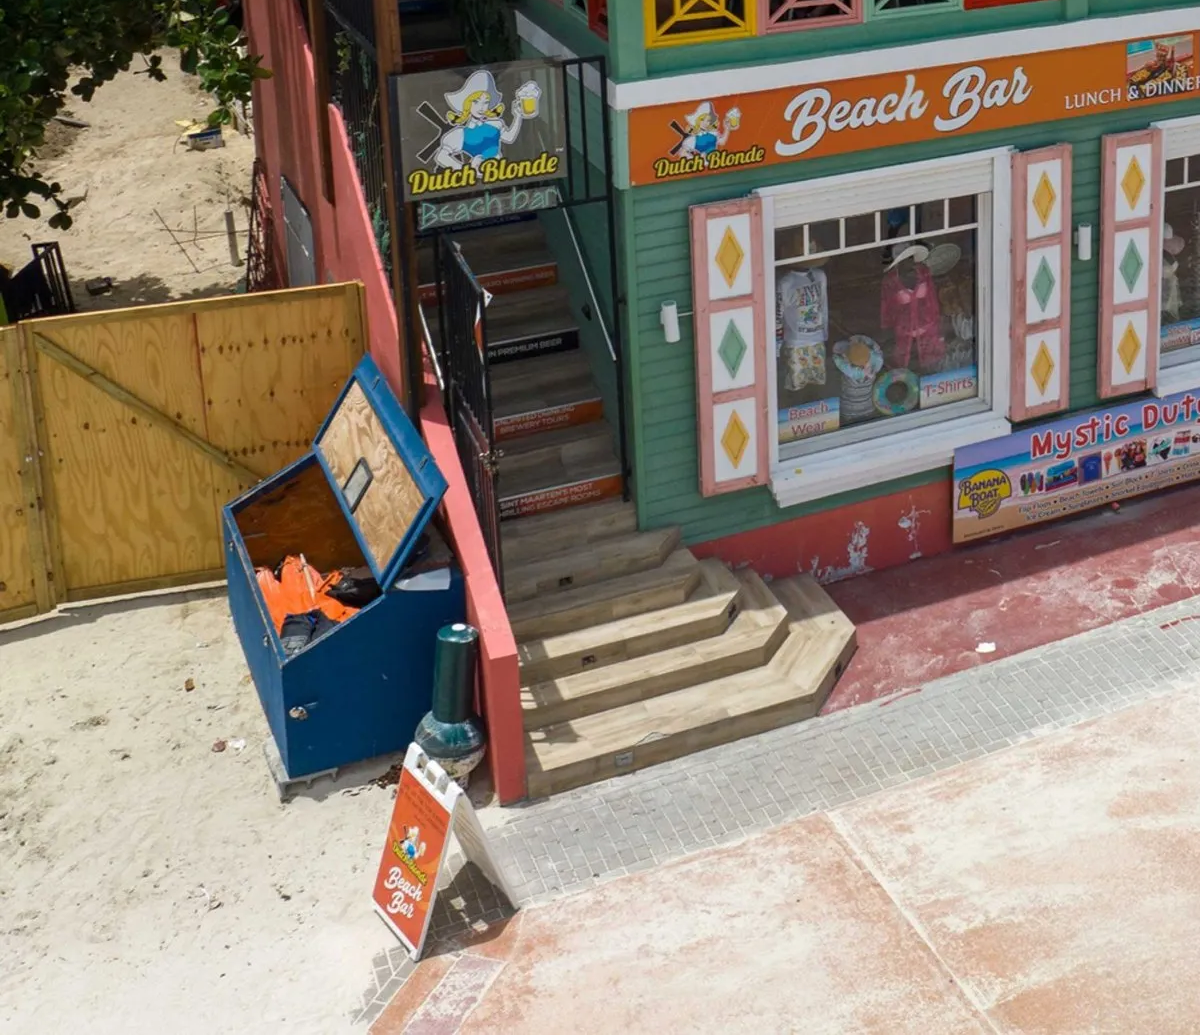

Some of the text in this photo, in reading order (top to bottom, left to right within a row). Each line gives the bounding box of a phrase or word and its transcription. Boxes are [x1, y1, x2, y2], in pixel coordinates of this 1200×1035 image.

[1065, 88, 1121, 110] LUNCH
[1128, 84, 1139, 101] &
[775, 66, 1032, 156] Beach Bar
[408, 152, 559, 194] Dutch Blonde
[653, 146, 765, 178] Dutch Blonde
[924, 377, 973, 396] T-Shirts
[789, 402, 829, 421] Beach
[791, 419, 826, 435] Wear
[1030, 413, 1130, 461] Mystic
[962, 476, 1006, 496] BANANA
[970, 488, 998, 511] BOAT
[384, 866, 423, 902] Beach
[386, 891, 414, 918] Bar
